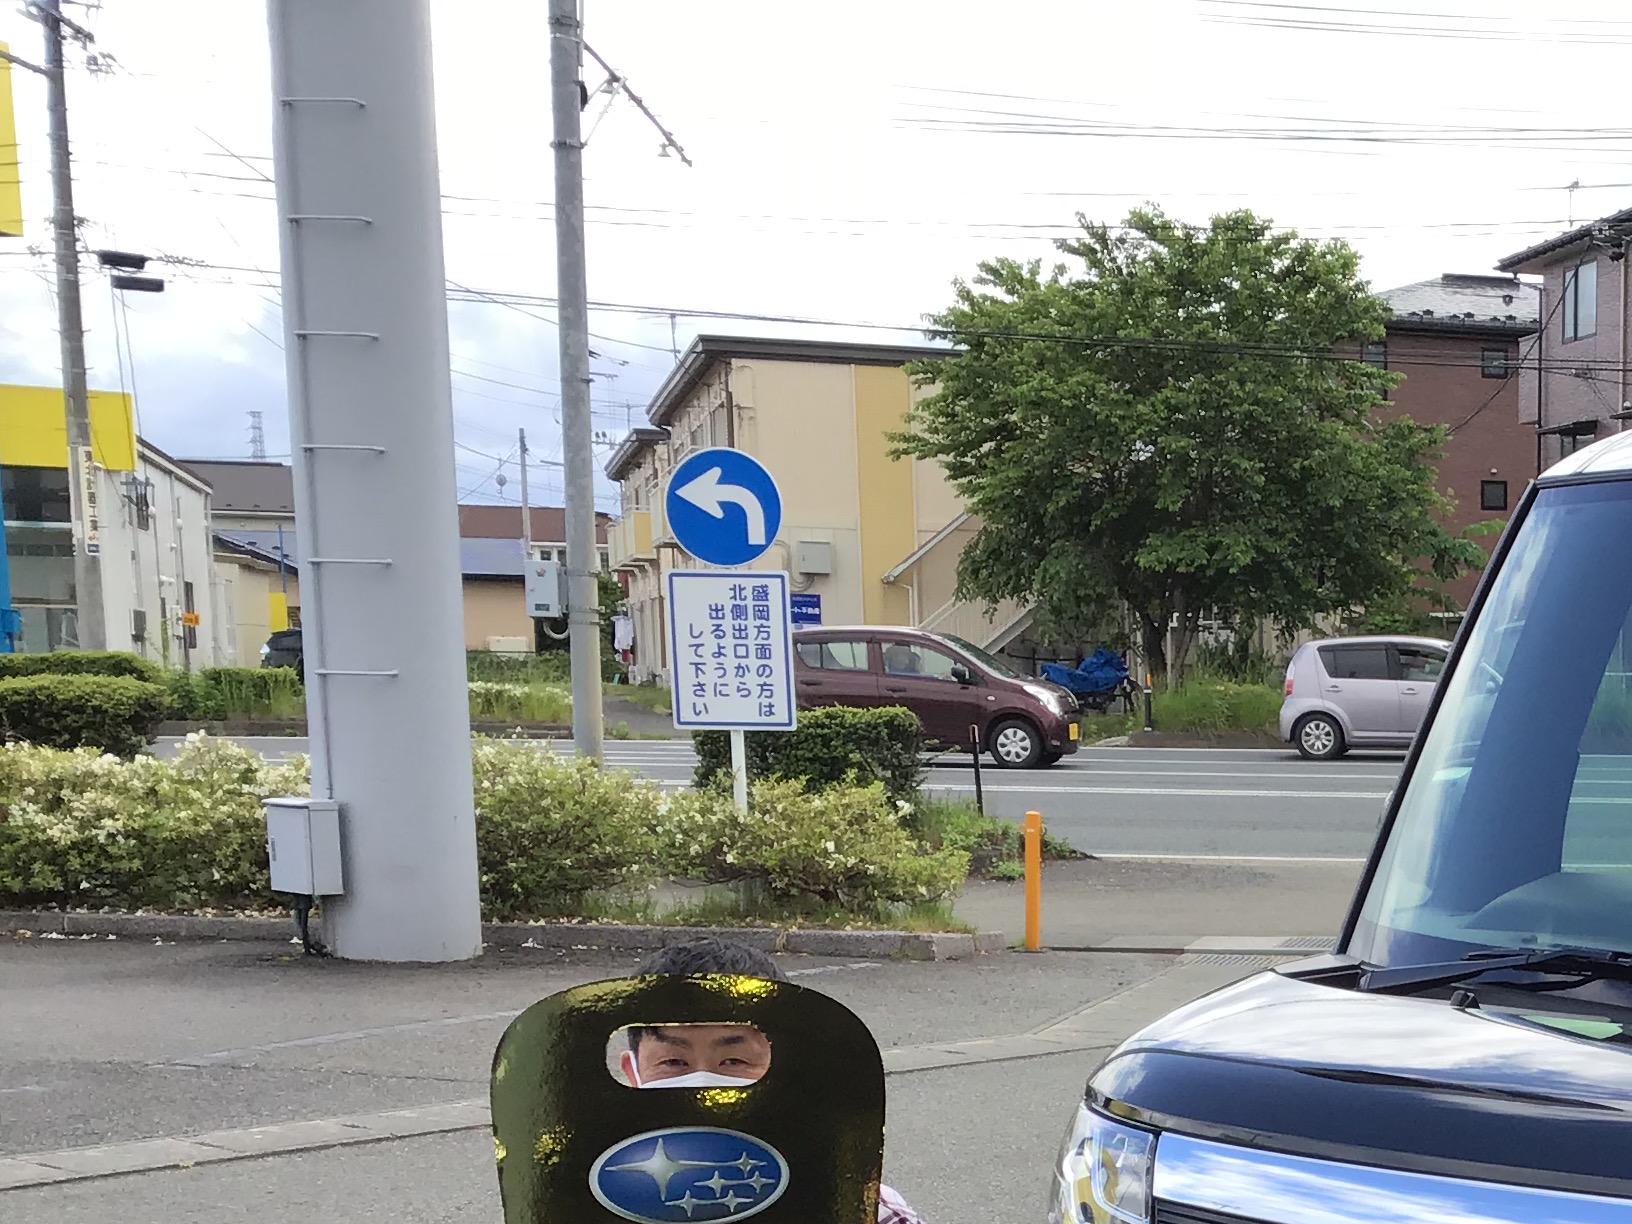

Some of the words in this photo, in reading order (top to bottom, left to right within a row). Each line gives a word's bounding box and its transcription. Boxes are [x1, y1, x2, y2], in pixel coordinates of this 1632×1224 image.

[688, 623, 709, 717] して下さい
[708, 603, 730, 698] 出るように
[729, 583, 751, 698] 北側出口から
[751, 583, 776, 717] 盛岡方面の方は
